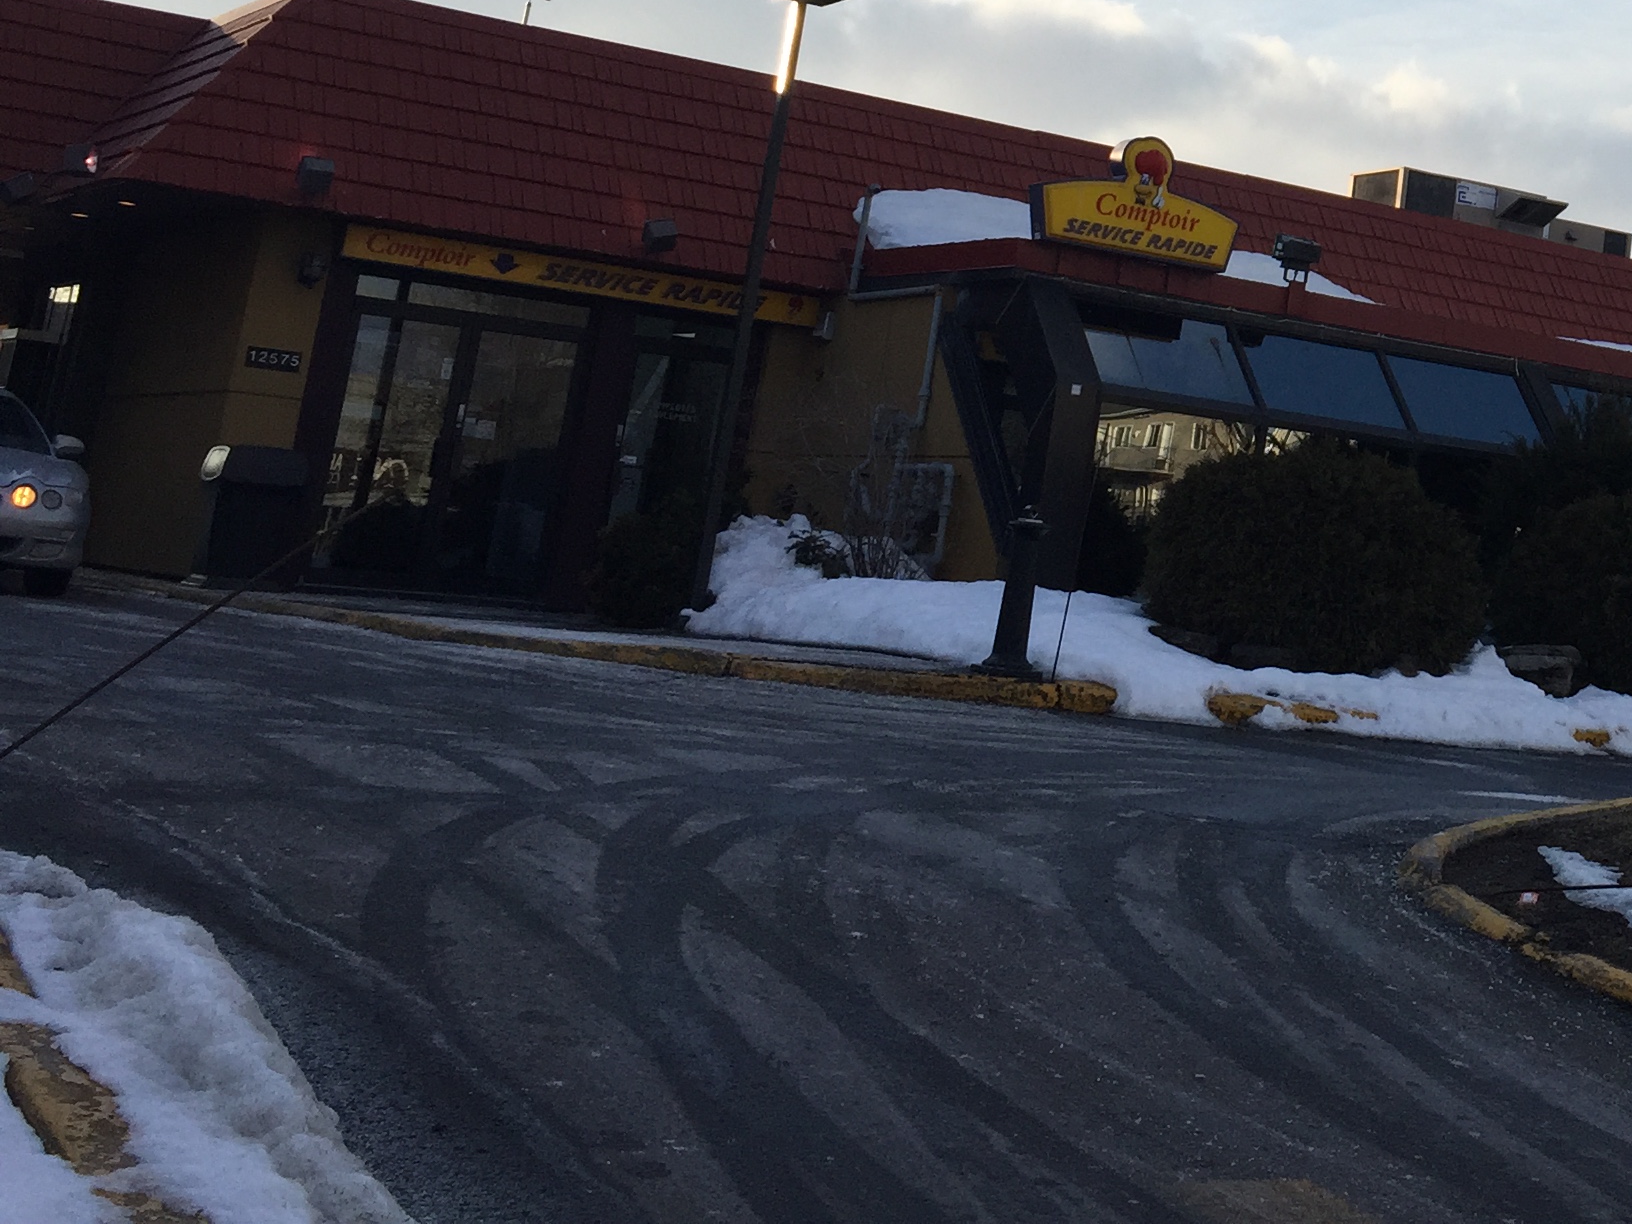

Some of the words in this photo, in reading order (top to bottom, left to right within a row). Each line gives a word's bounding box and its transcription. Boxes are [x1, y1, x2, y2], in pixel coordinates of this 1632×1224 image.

[1096, 193, 1200, 233] Comptoir
[1063, 218, 1145, 246] SERVICE
[1146, 233, 1218, 260] RAPIDE
[366, 231, 476, 269] Comptoir
[537, 262, 660, 296] SERVICE
[249, 350, 300, 367] 12575
